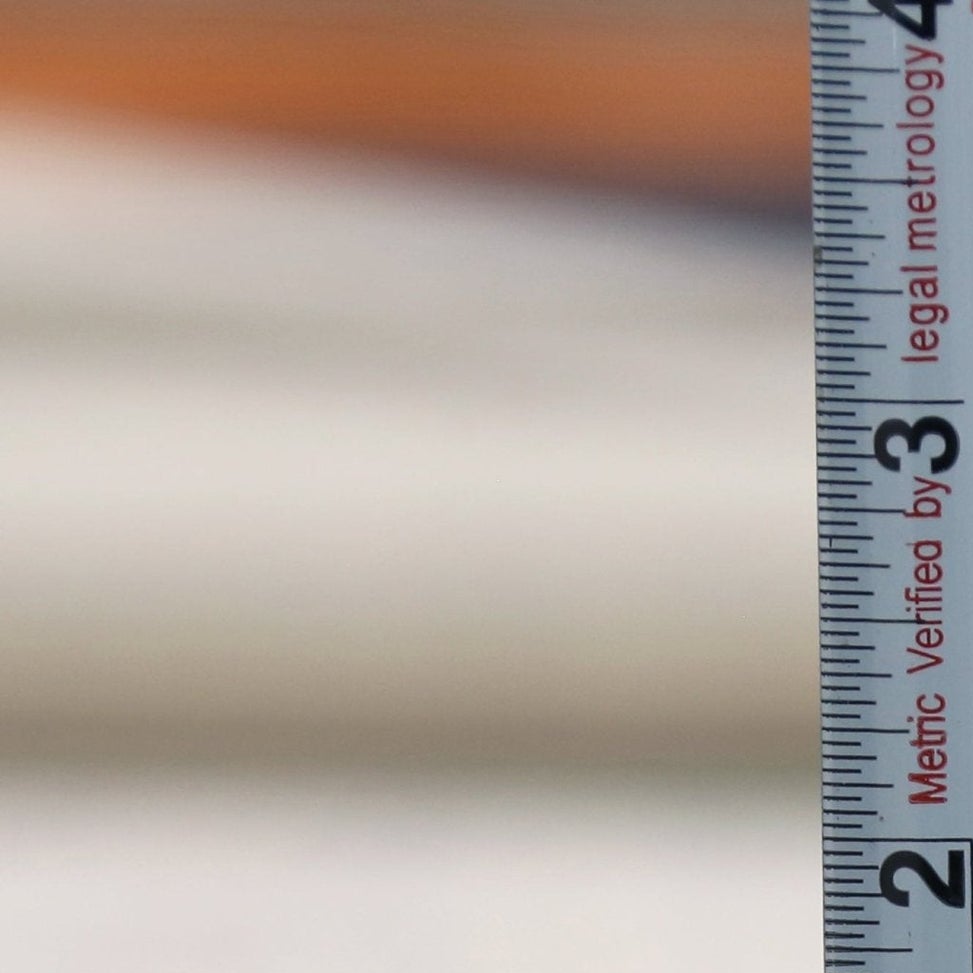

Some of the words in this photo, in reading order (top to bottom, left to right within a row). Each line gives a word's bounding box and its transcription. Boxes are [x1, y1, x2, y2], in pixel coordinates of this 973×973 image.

[868, 0, 951, 41] 4
[896, 43, 945, 254] metrology
[901, 265, 949, 363] legal
[874, 416, 960, 475] 3
[903, 476, 951, 519] by
[904, 540, 946, 674] Verified
[907, 693, 948, 805] Metric
[880, 850, 966, 909] 2
